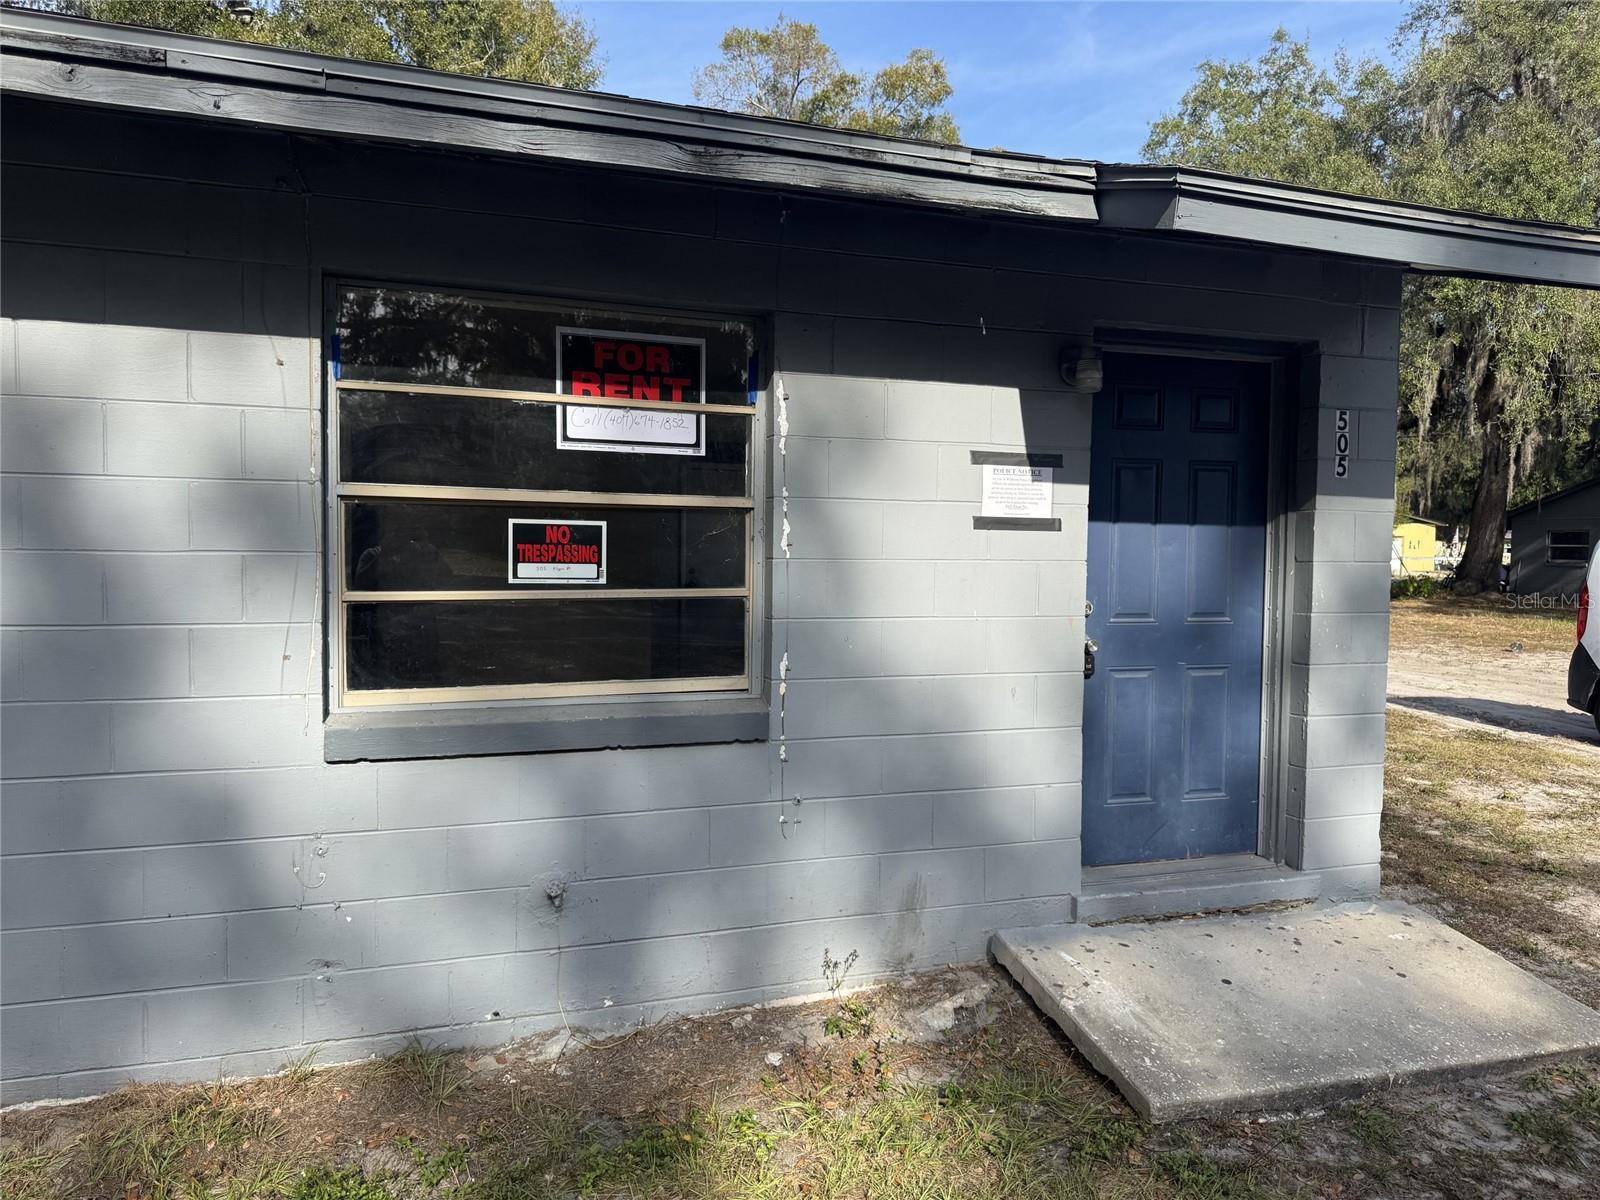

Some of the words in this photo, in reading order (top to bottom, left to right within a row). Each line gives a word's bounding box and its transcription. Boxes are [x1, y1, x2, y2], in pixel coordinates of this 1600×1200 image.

[593, 341, 670, 373] FOR
[571, 370, 691, 404] RENT
[571, 407, 601, 428] Call
[1336, 411, 1348, 477] 505
[545, 525, 571, 544] NO
[517, 543, 599, 563] TRESPASSING
